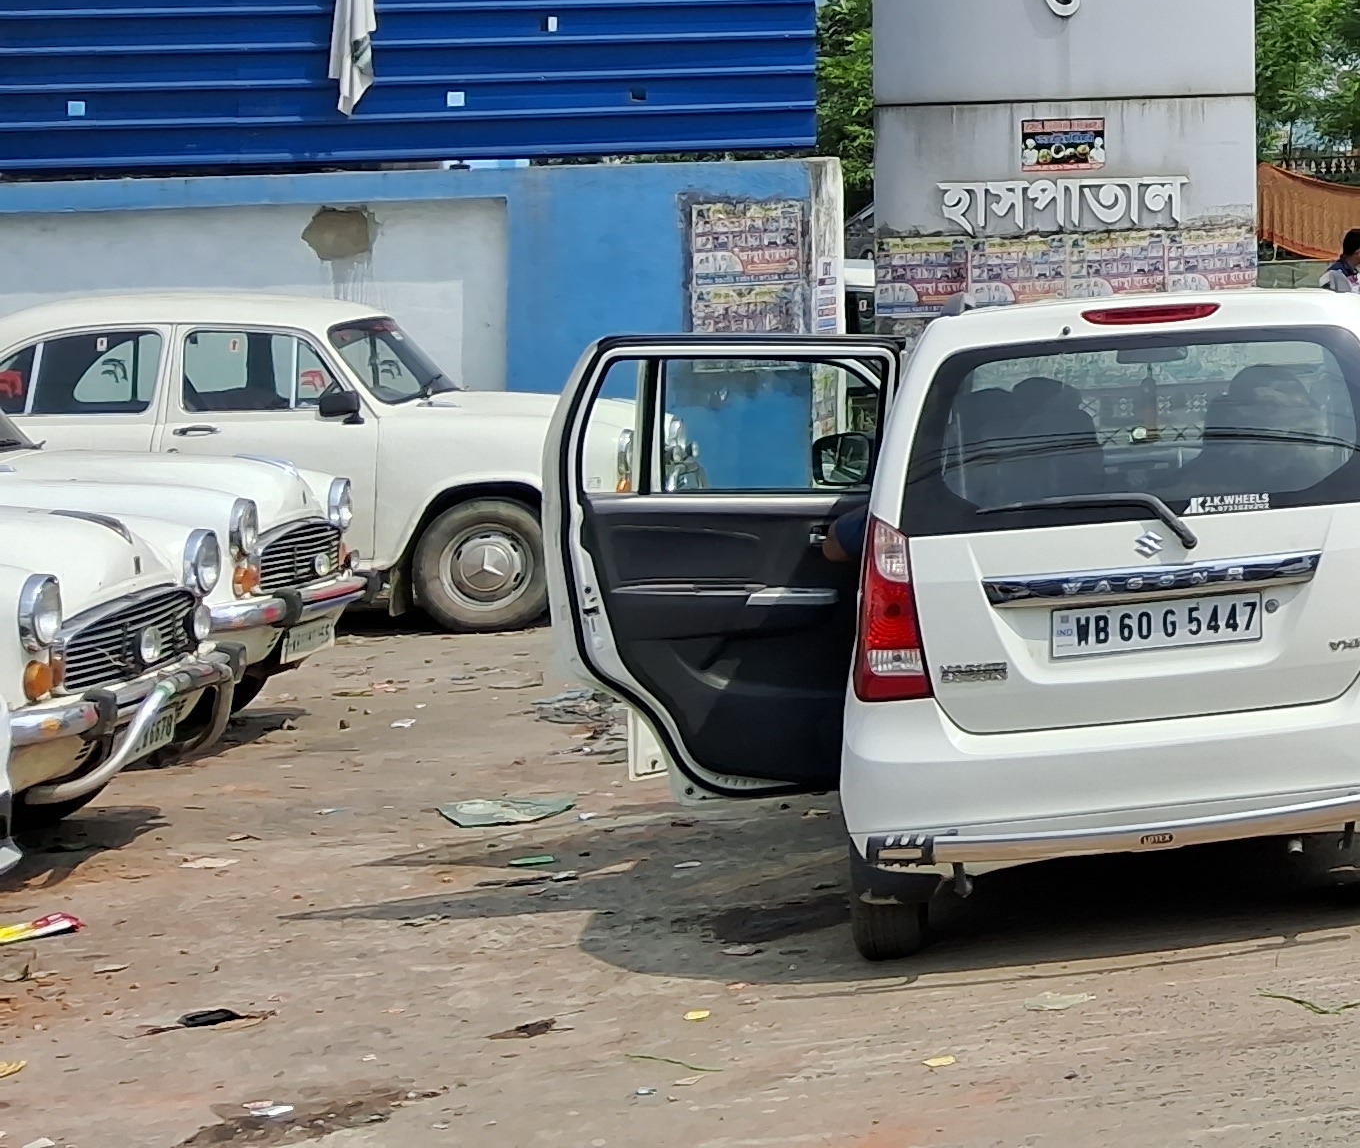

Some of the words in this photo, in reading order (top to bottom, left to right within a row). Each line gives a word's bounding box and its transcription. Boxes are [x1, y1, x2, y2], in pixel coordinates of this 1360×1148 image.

[936, 175, 1191, 237] হাসপাতাল
[1075, 614, 1110, 647] WB
[1119, 611, 1152, 642] 60
[1162, 609, 1177, 637] G
[1187, 601, 1258, 636] 5447
